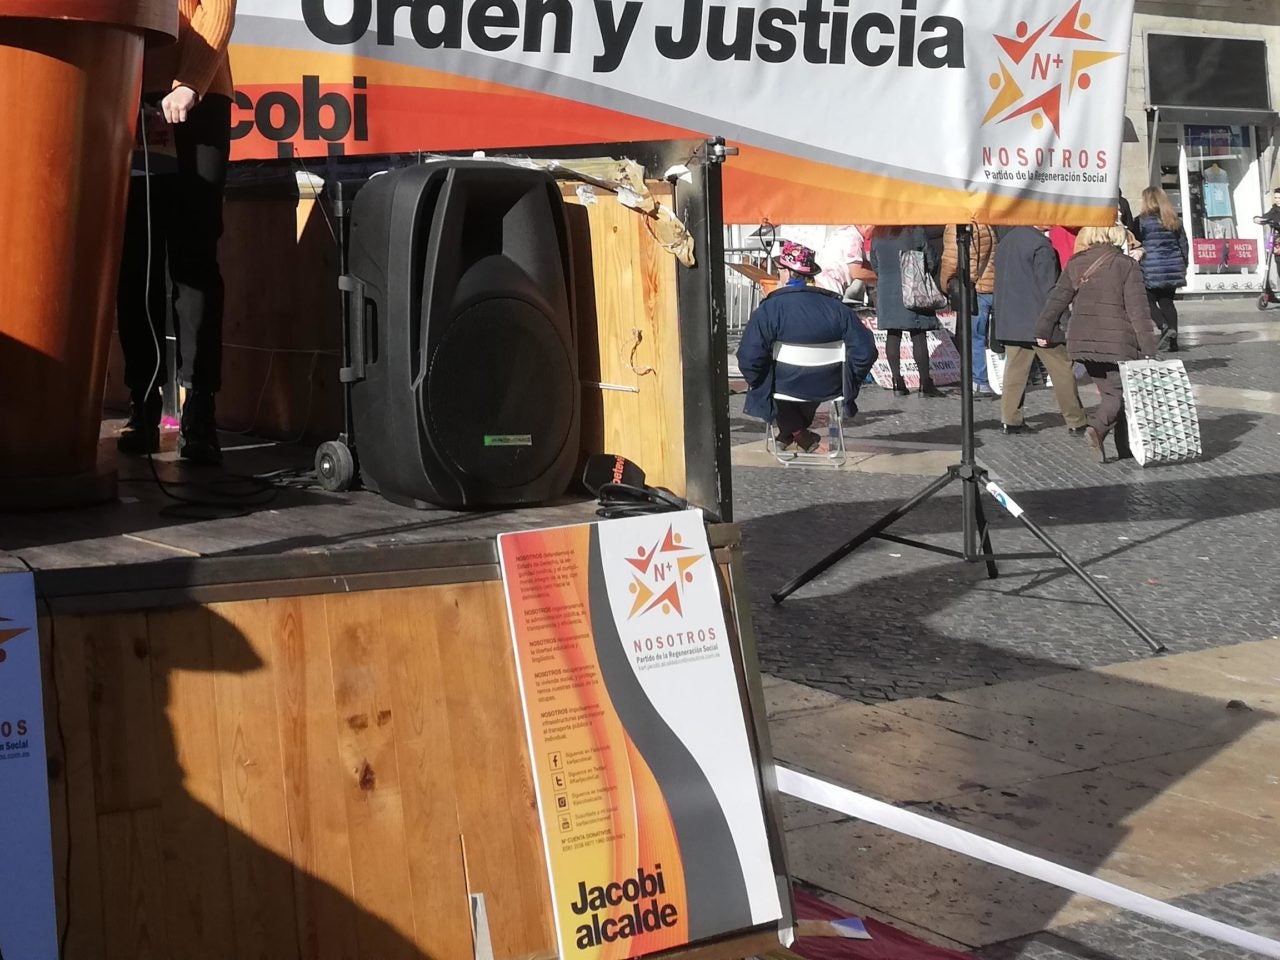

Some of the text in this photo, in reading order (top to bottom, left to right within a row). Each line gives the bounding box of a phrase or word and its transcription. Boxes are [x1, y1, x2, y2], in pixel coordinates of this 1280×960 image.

[593, 0, 641, 73] y
[982, 147, 1107, 169] NOSOTROS
[984, 170, 1014, 180] Partido
[1016, 171, 1027, 180] de
[1033, 170, 1081, 183] Regeneración
[1082, 172, 1107, 183] Social
[633, 627, 716, 653] NOSOTROS
[636, 652, 655, 663] Partido
[656, 652, 662, 660] de
[669, 645, 702, 658] Regeneración
[703, 643, 718, 653] Social
[6, 739, 28, 750] Social
[571, 863, 665, 915] Jacobi
[575, 899, 678, 950] alcalde
